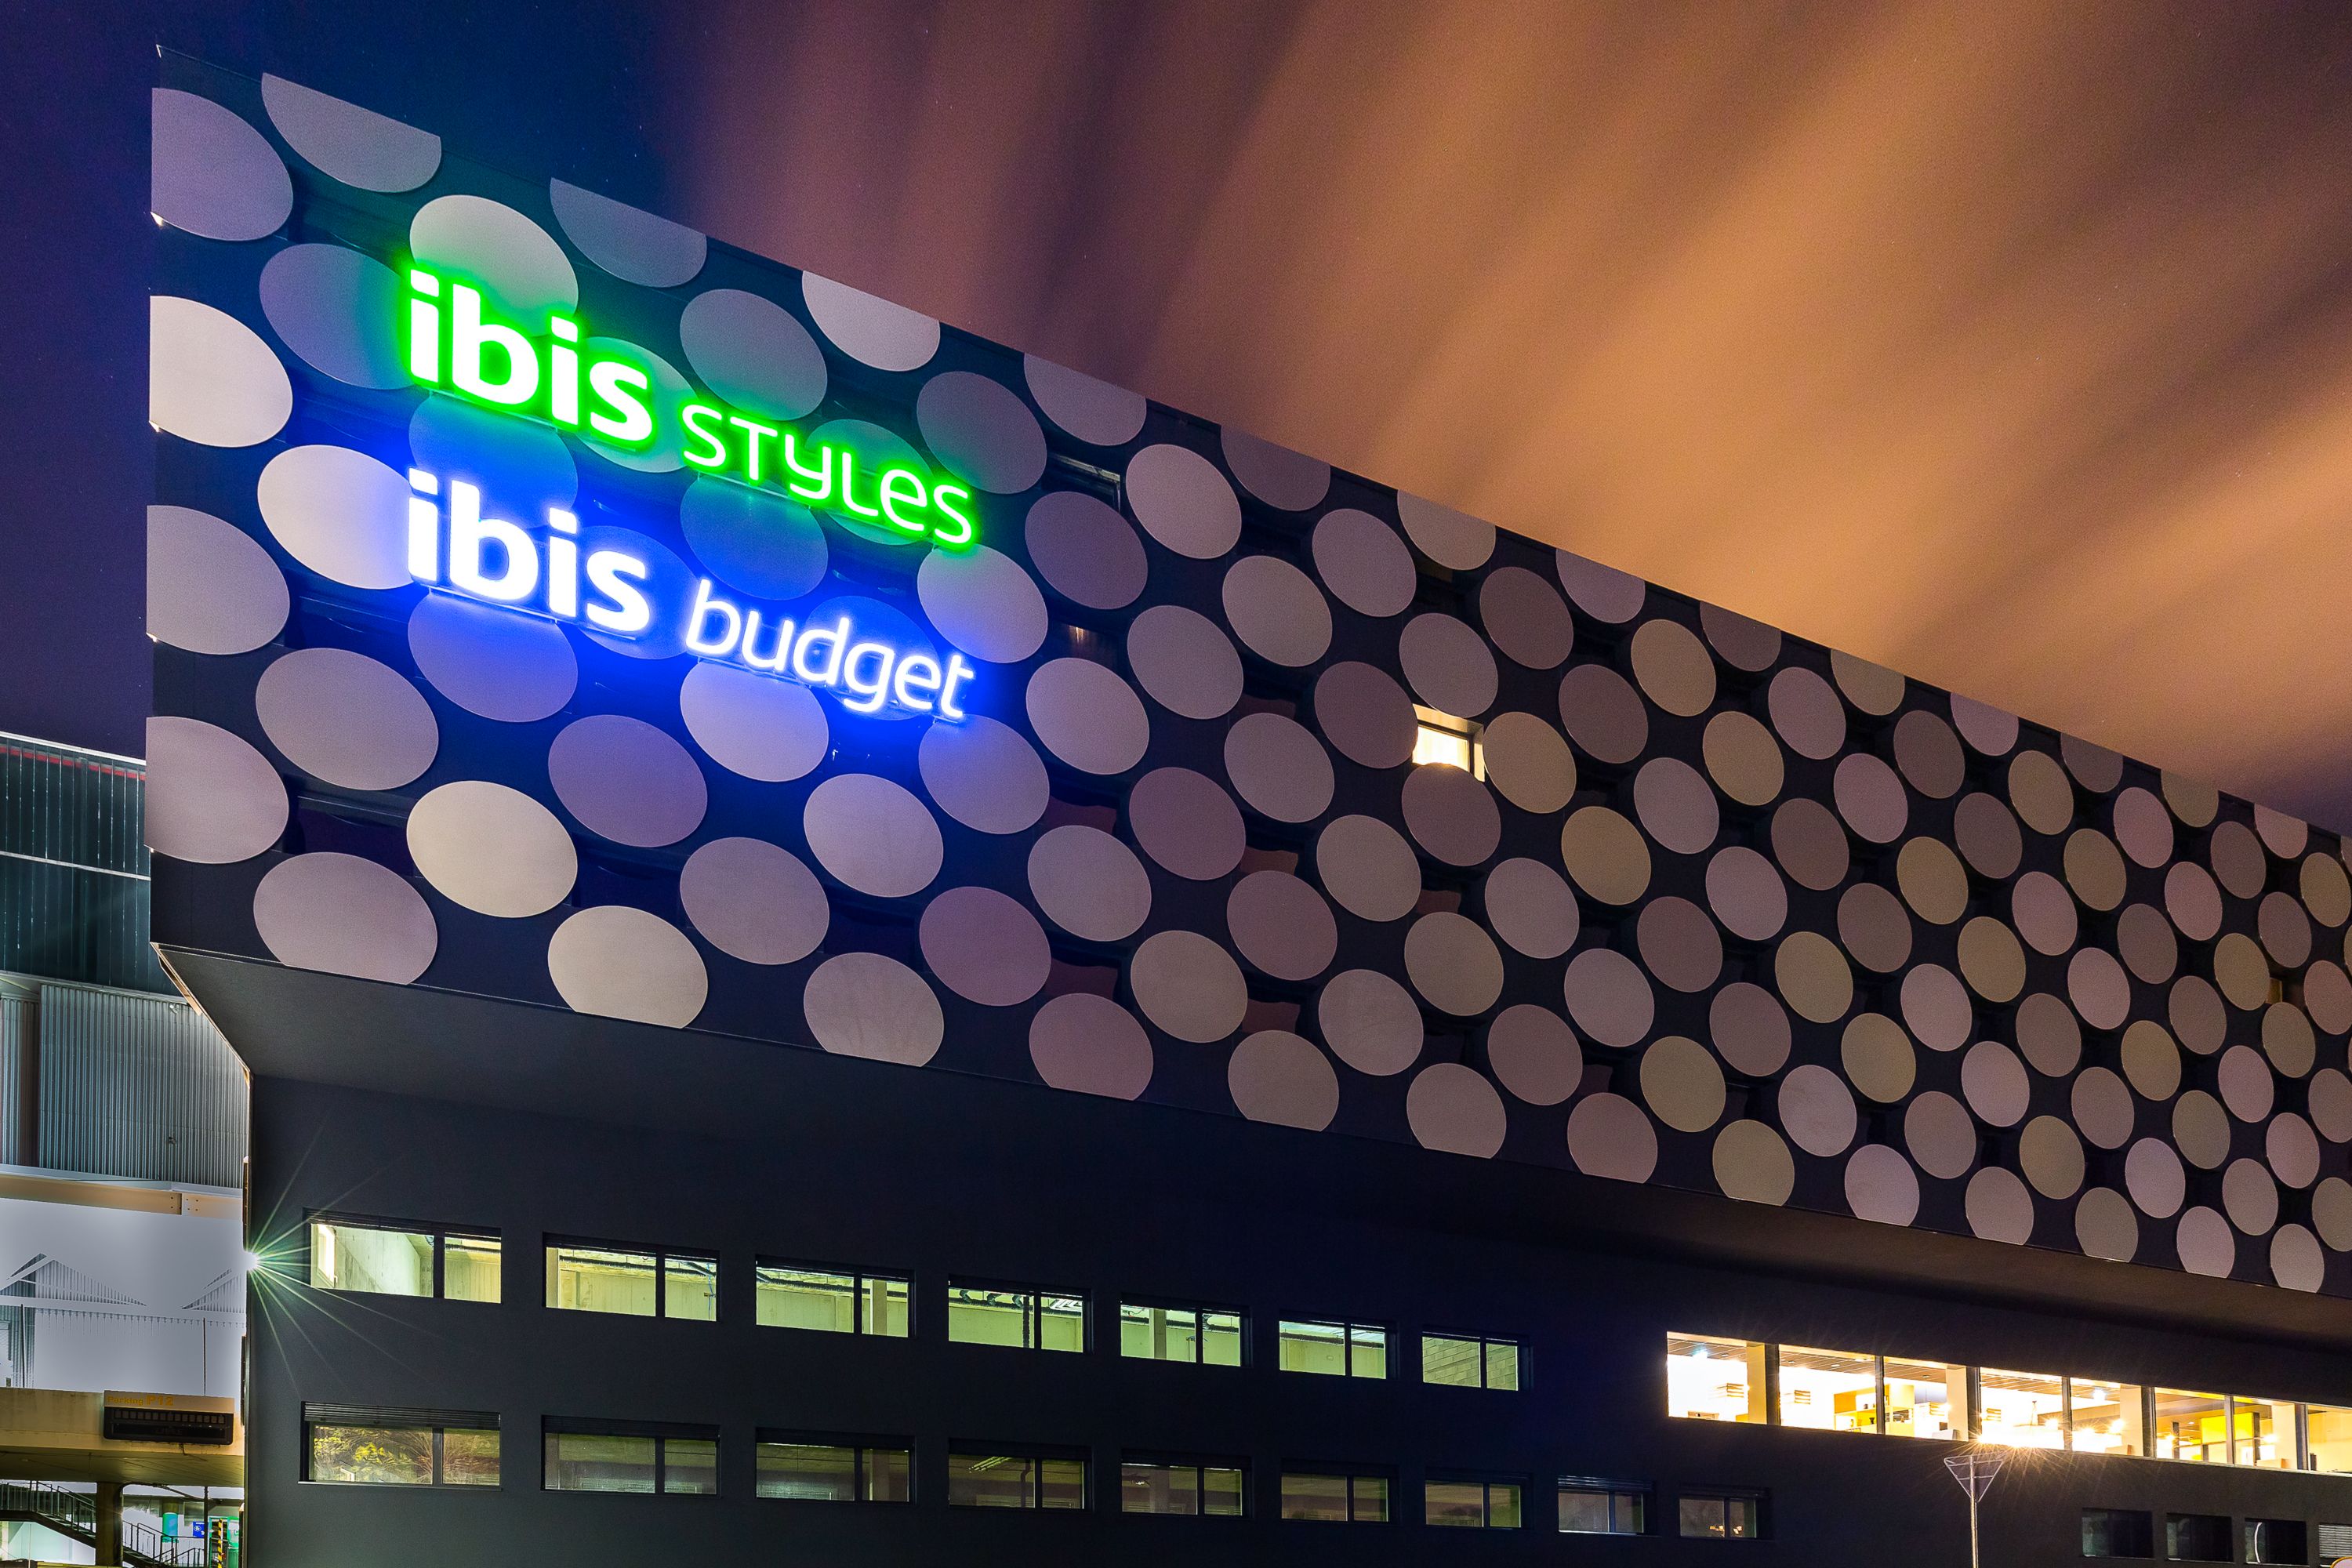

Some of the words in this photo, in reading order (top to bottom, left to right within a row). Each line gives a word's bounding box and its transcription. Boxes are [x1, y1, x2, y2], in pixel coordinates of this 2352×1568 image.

[408, 269, 653, 441] ibis
[407, 466, 651, 633] ibis
[684, 578, 975, 718] budget
[107, 1396, 143, 1406] Parking
[147, 1395, 174, 1406] P12
